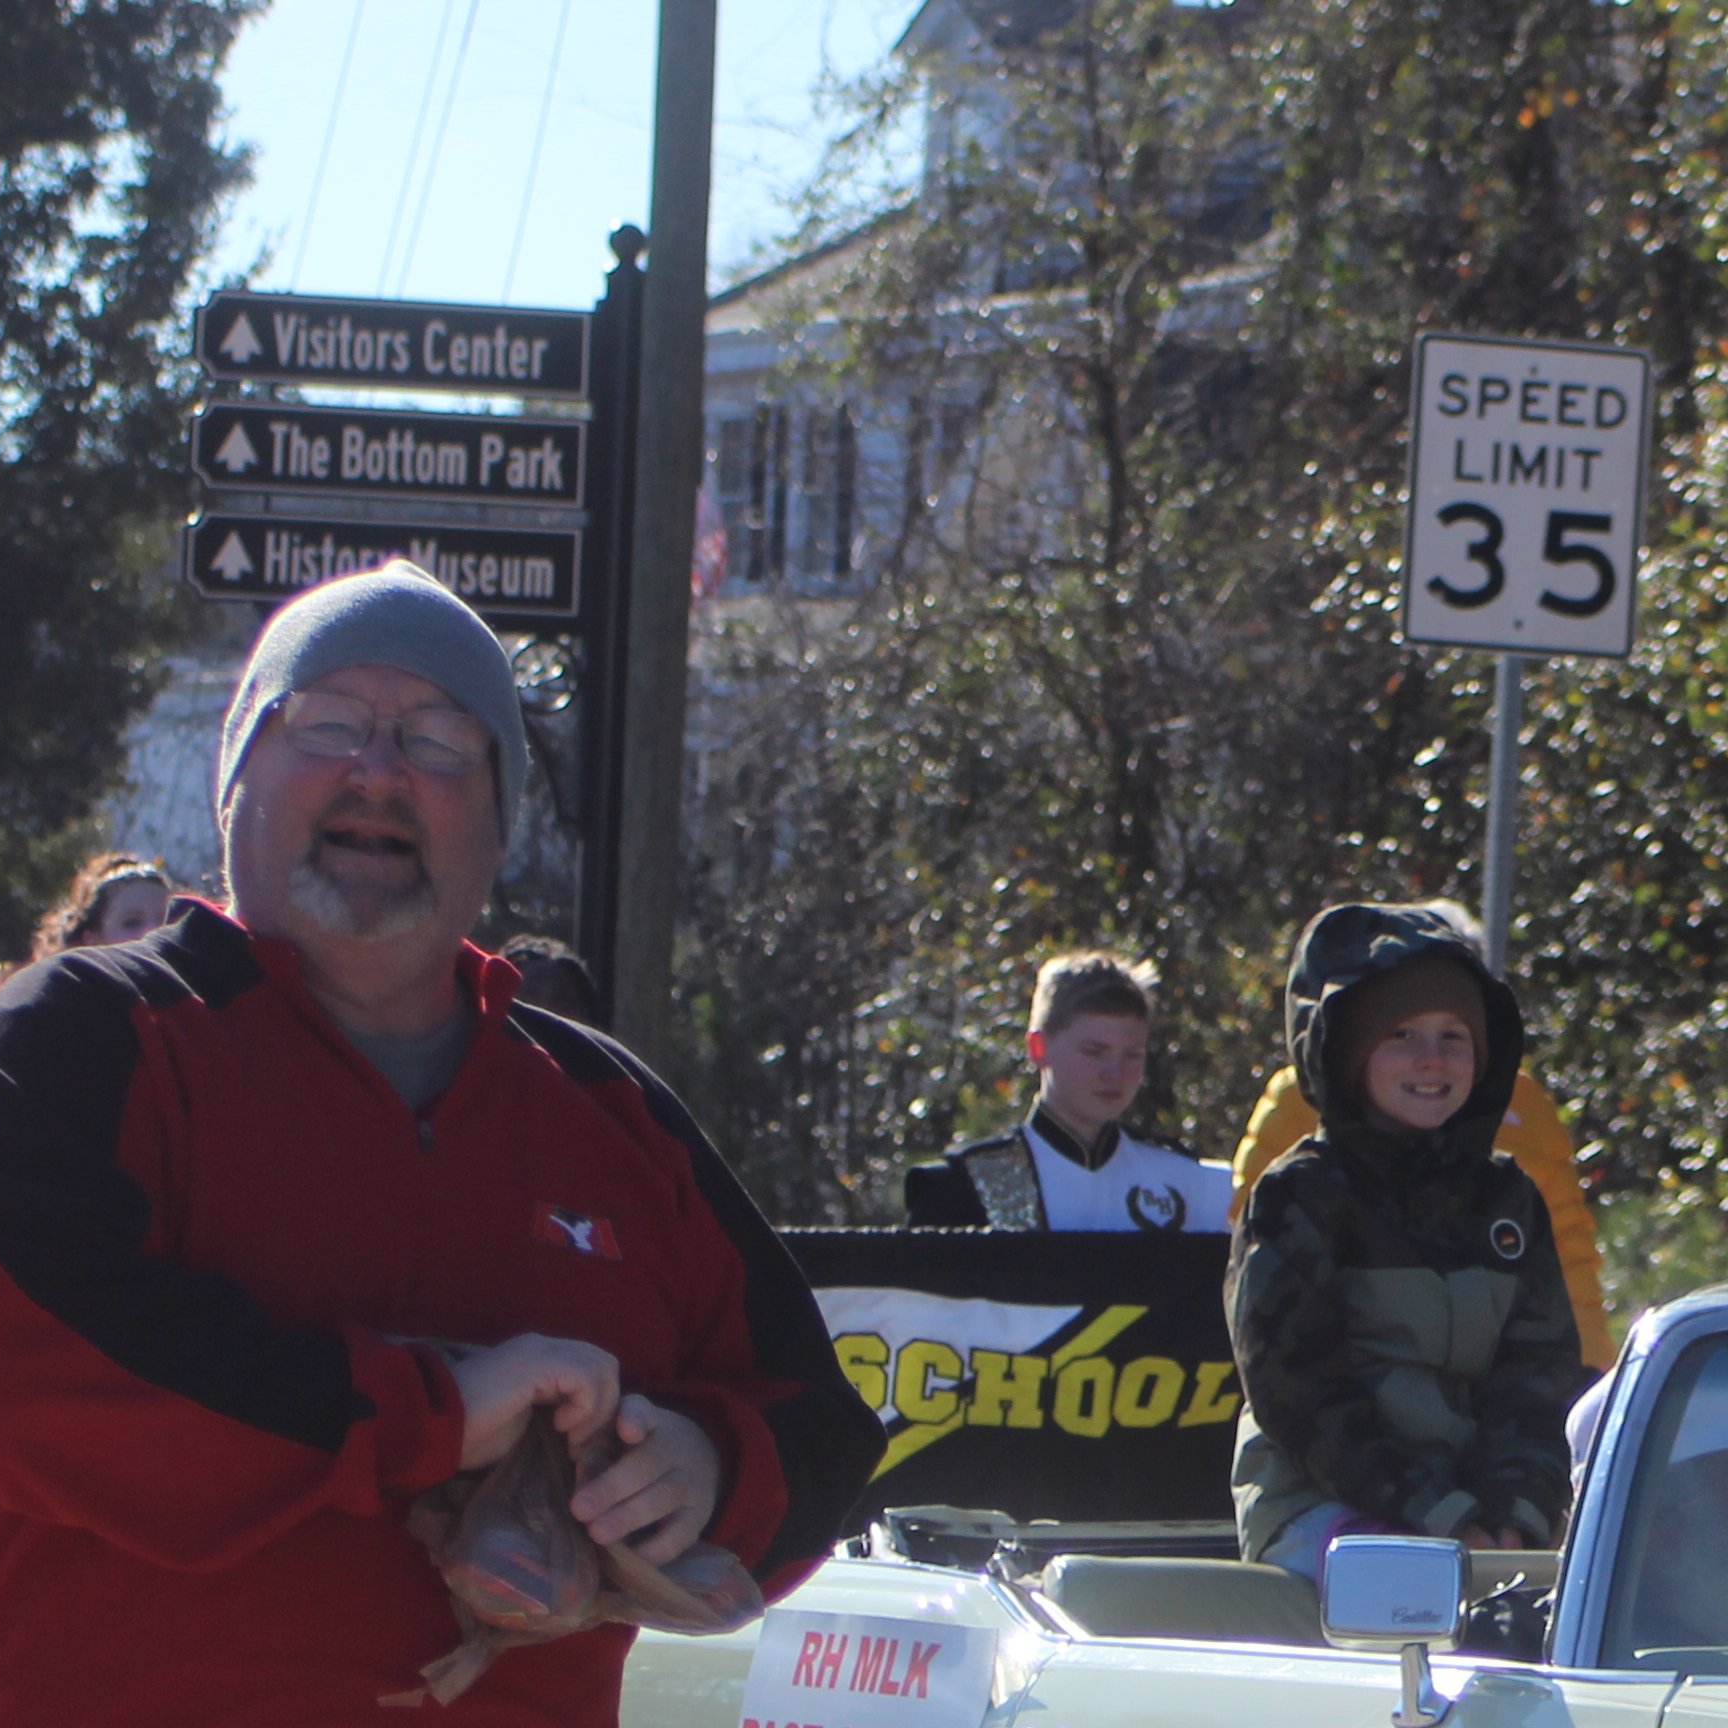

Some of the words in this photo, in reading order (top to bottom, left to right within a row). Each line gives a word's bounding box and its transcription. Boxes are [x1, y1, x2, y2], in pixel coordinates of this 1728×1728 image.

[272, 310, 411, 372] Visitors
[422, 318, 549, 380] Center
[1437, 372, 1628, 429] SPEED
[268, 421, 332, 480] The
[340, 424, 468, 486] Bottom
[478, 433, 565, 491] Park
[1454, 439, 1603, 492] LIMIT
[263, 530, 390, 586] Histor
[409, 537, 555, 598] Museum
[1425, 500, 1617, 620] 35
[833, 1332, 1241, 1438] SCHOOL
[791, 1631, 849, 1690] RH
[849, 1636, 943, 1699] MLK
